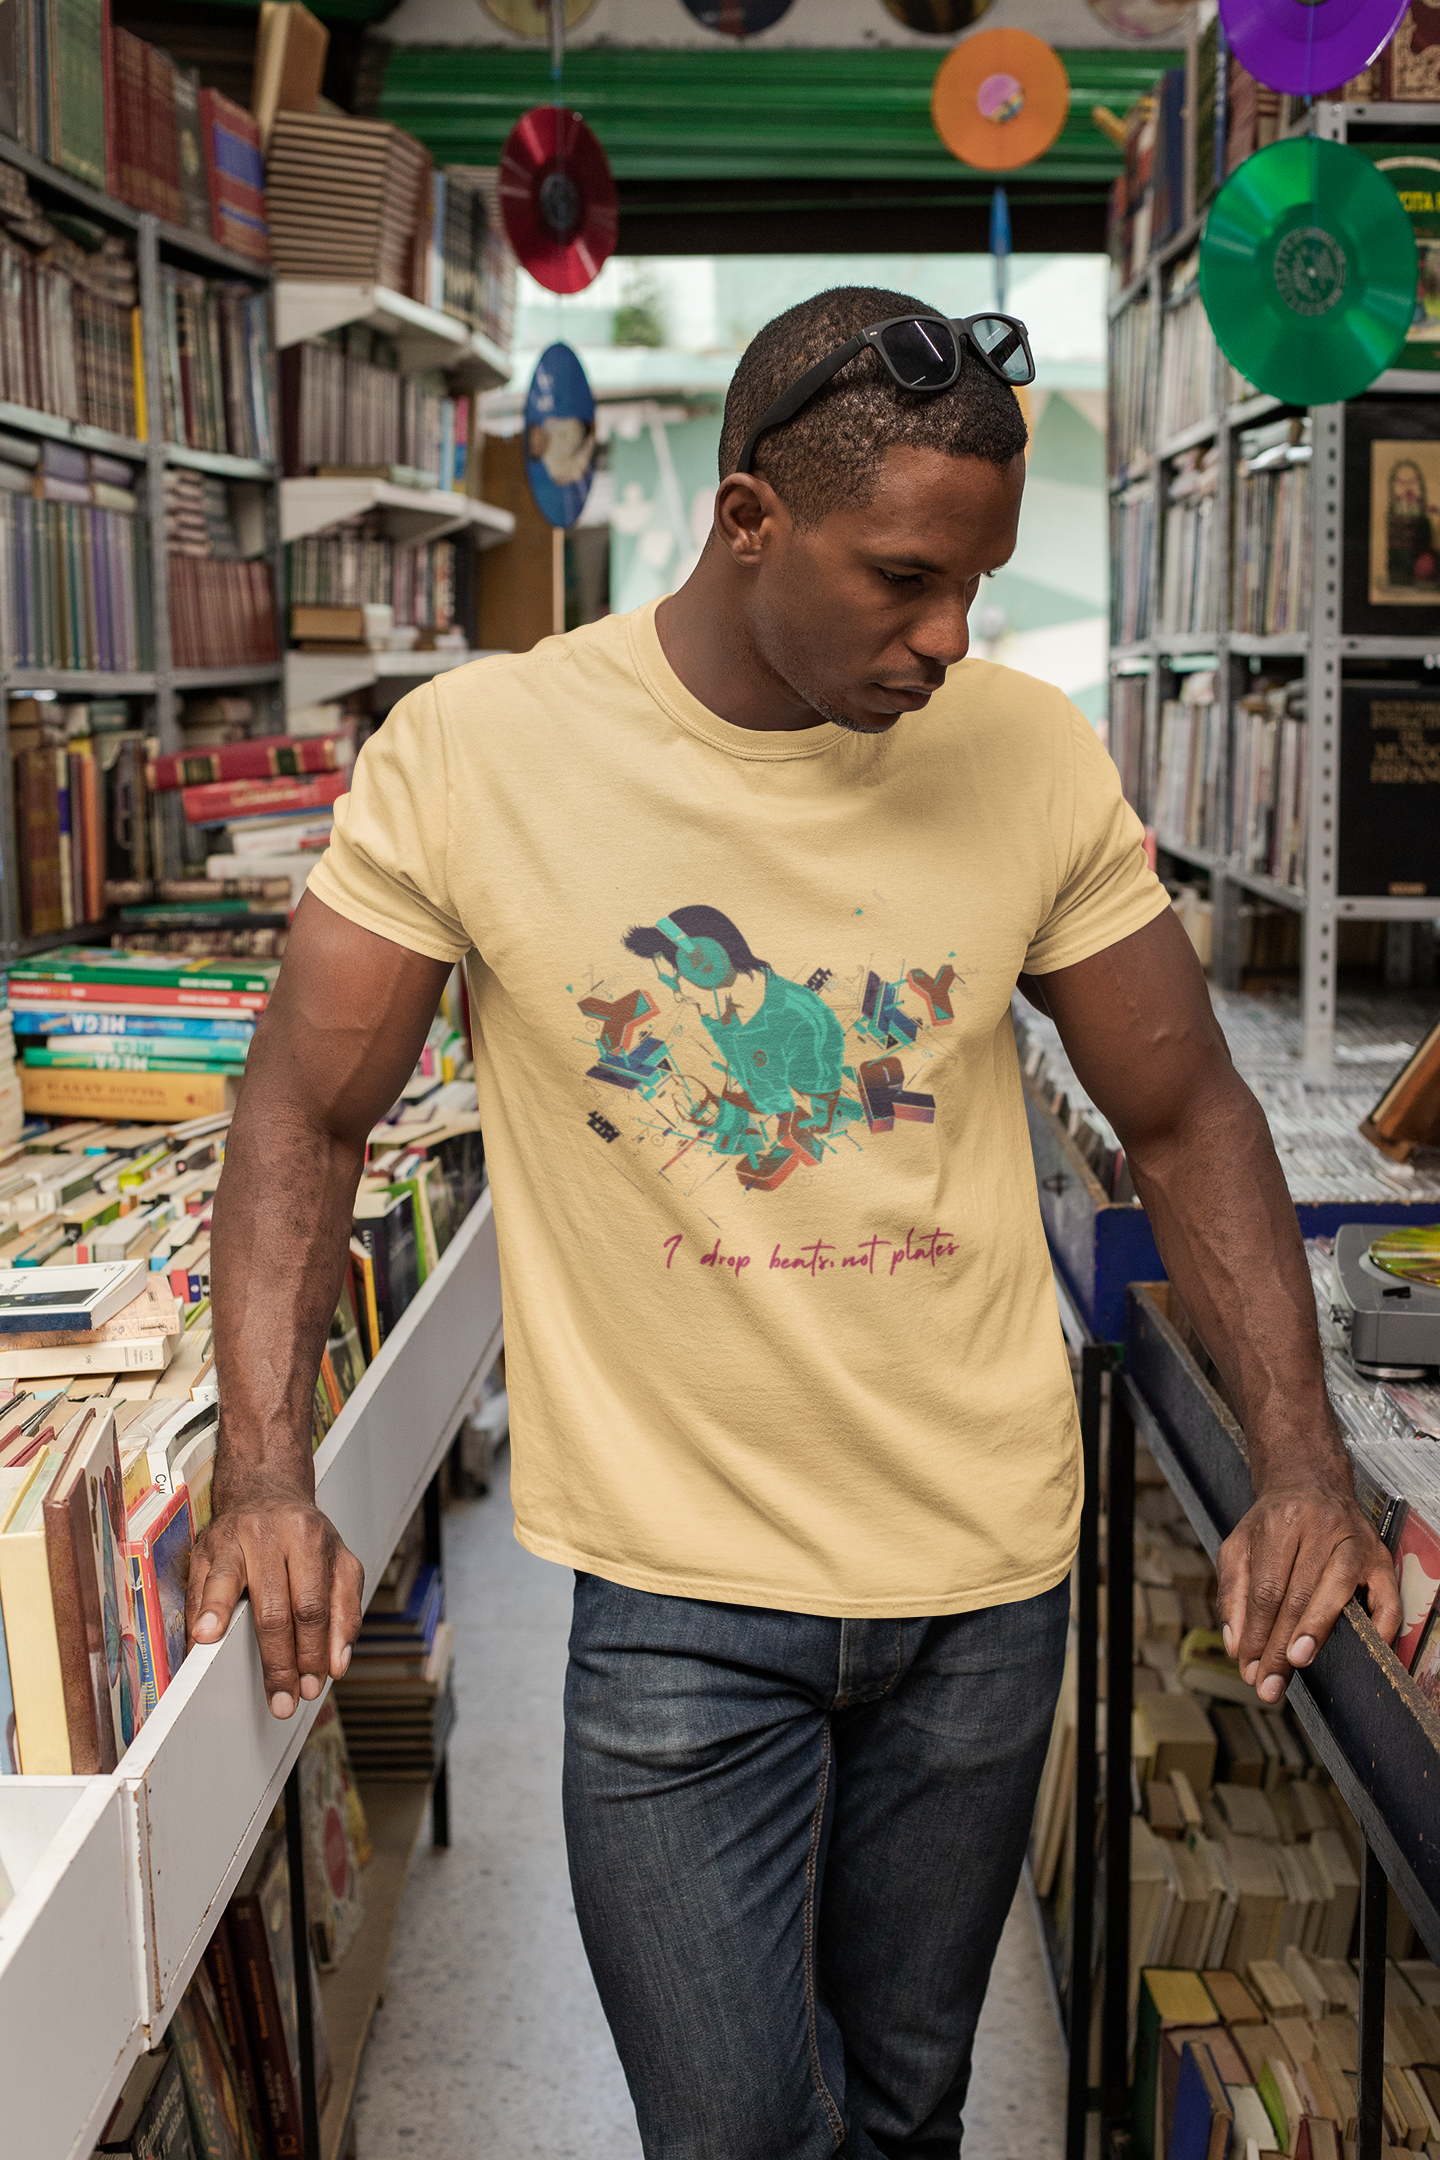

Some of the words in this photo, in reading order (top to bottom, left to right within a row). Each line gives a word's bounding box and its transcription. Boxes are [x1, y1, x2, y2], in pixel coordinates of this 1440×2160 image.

[71, 1014, 125, 1033] MEGA
[95, 1055, 148, 1071] MEGA
[700, 1238, 751, 1277] drop
[842, 1234, 892, 1274] not
[890, 1227, 960, 1276] plates
